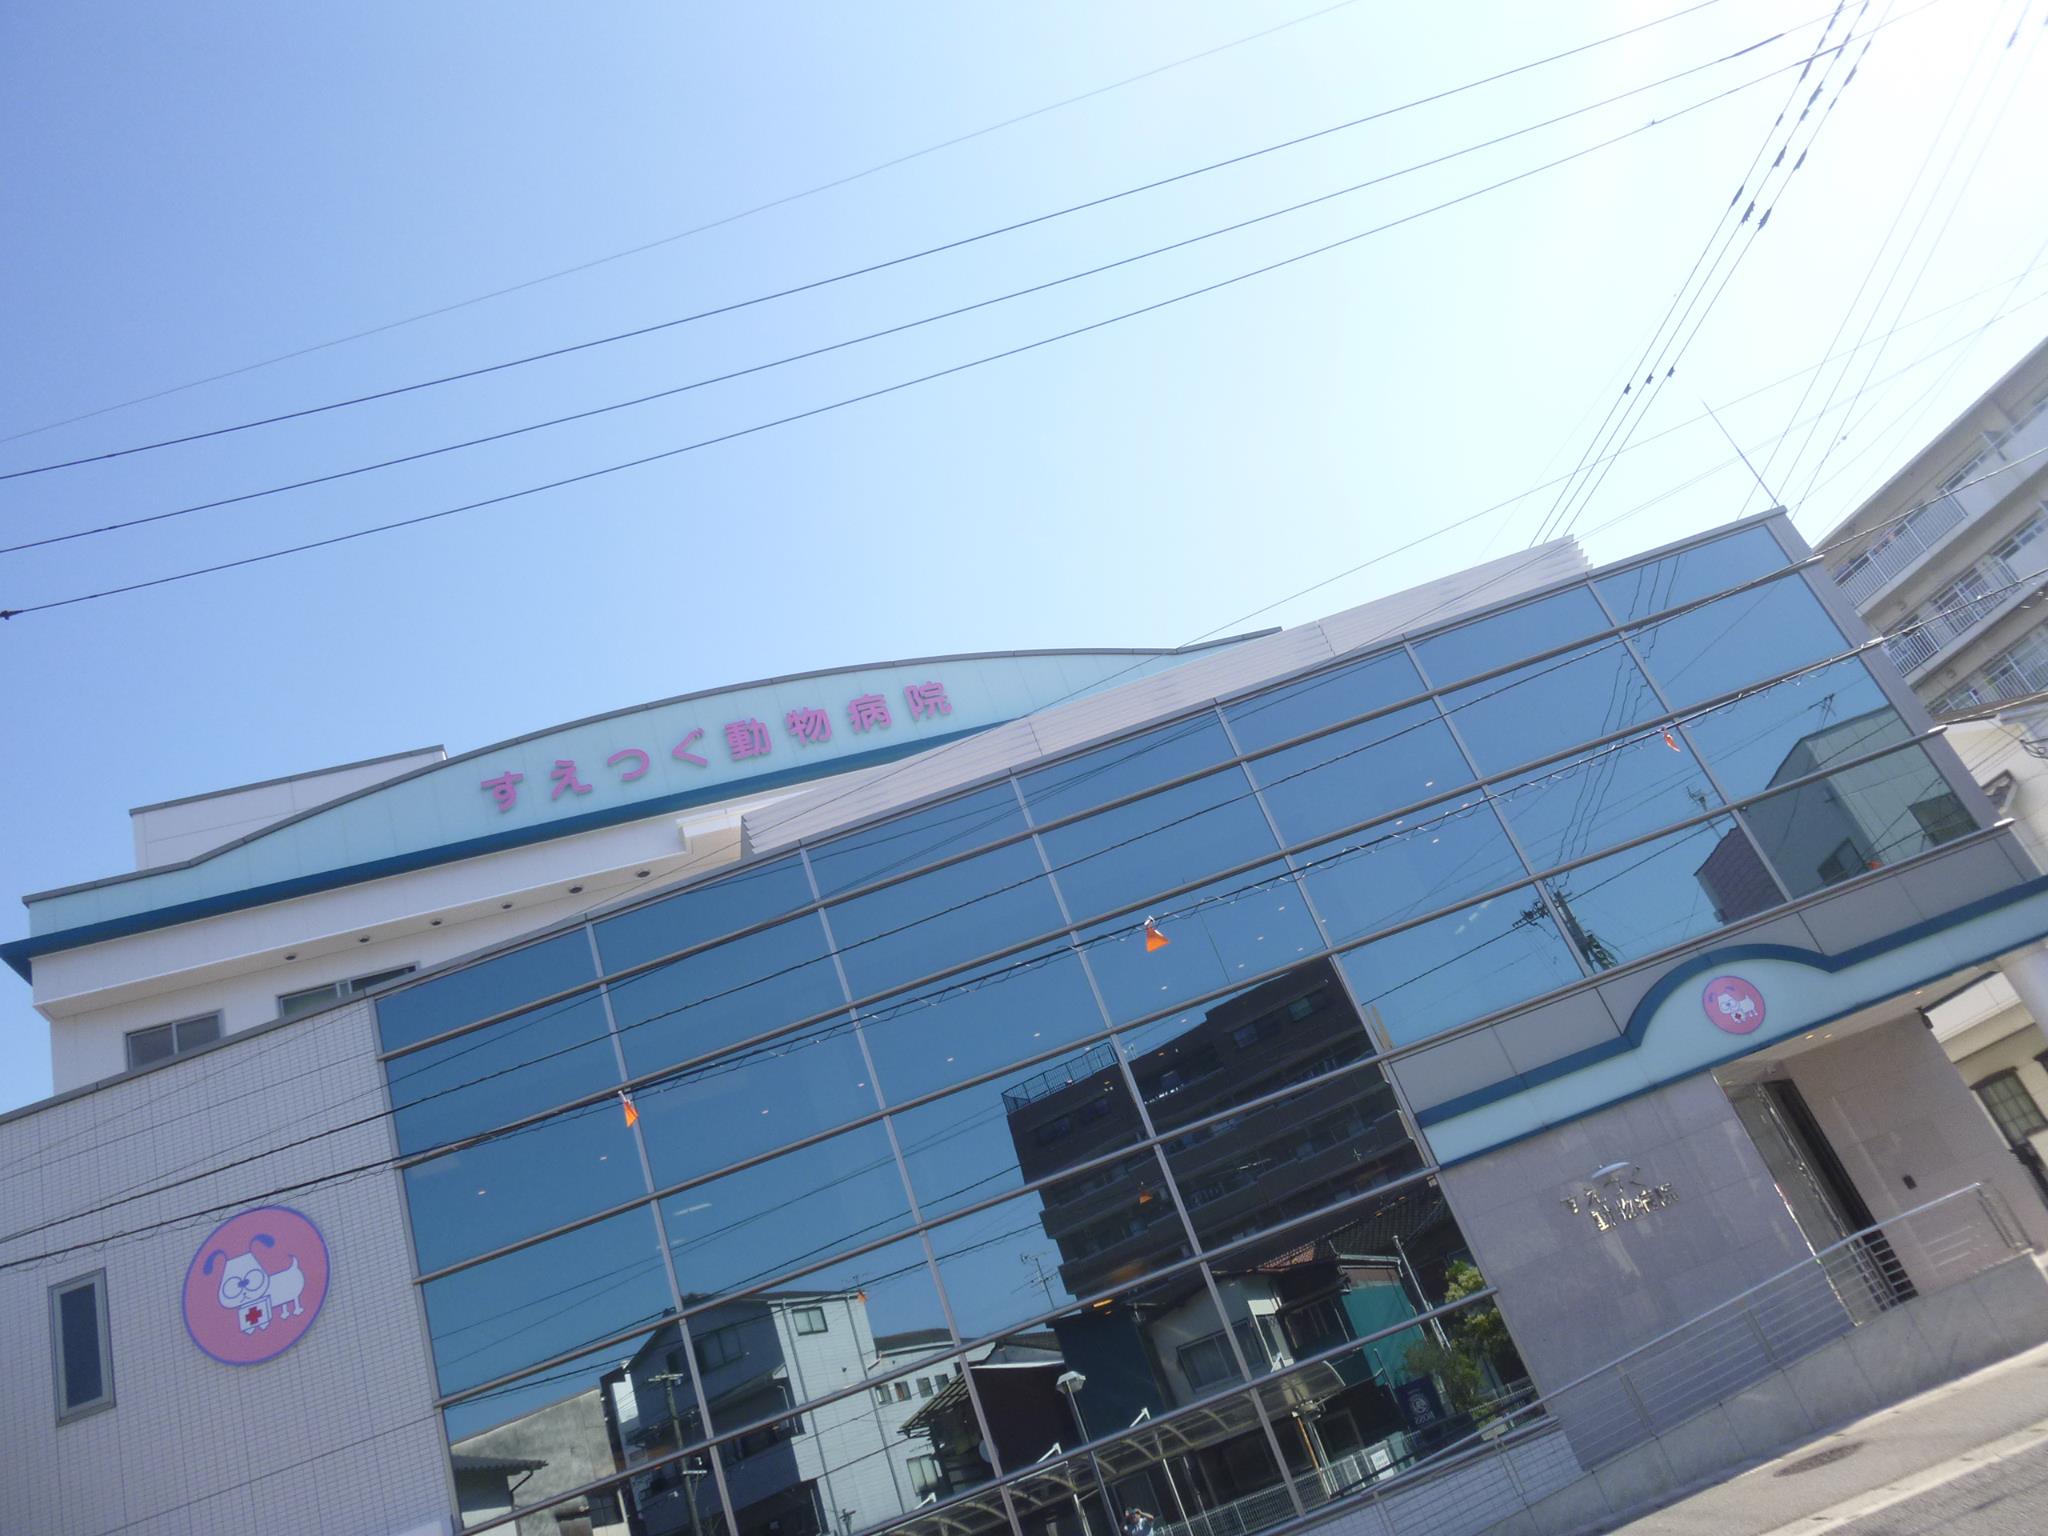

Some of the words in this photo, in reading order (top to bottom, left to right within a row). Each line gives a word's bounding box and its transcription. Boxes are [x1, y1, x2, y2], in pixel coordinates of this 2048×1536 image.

[481, 681, 953, 811] すえつぐ動物病院
